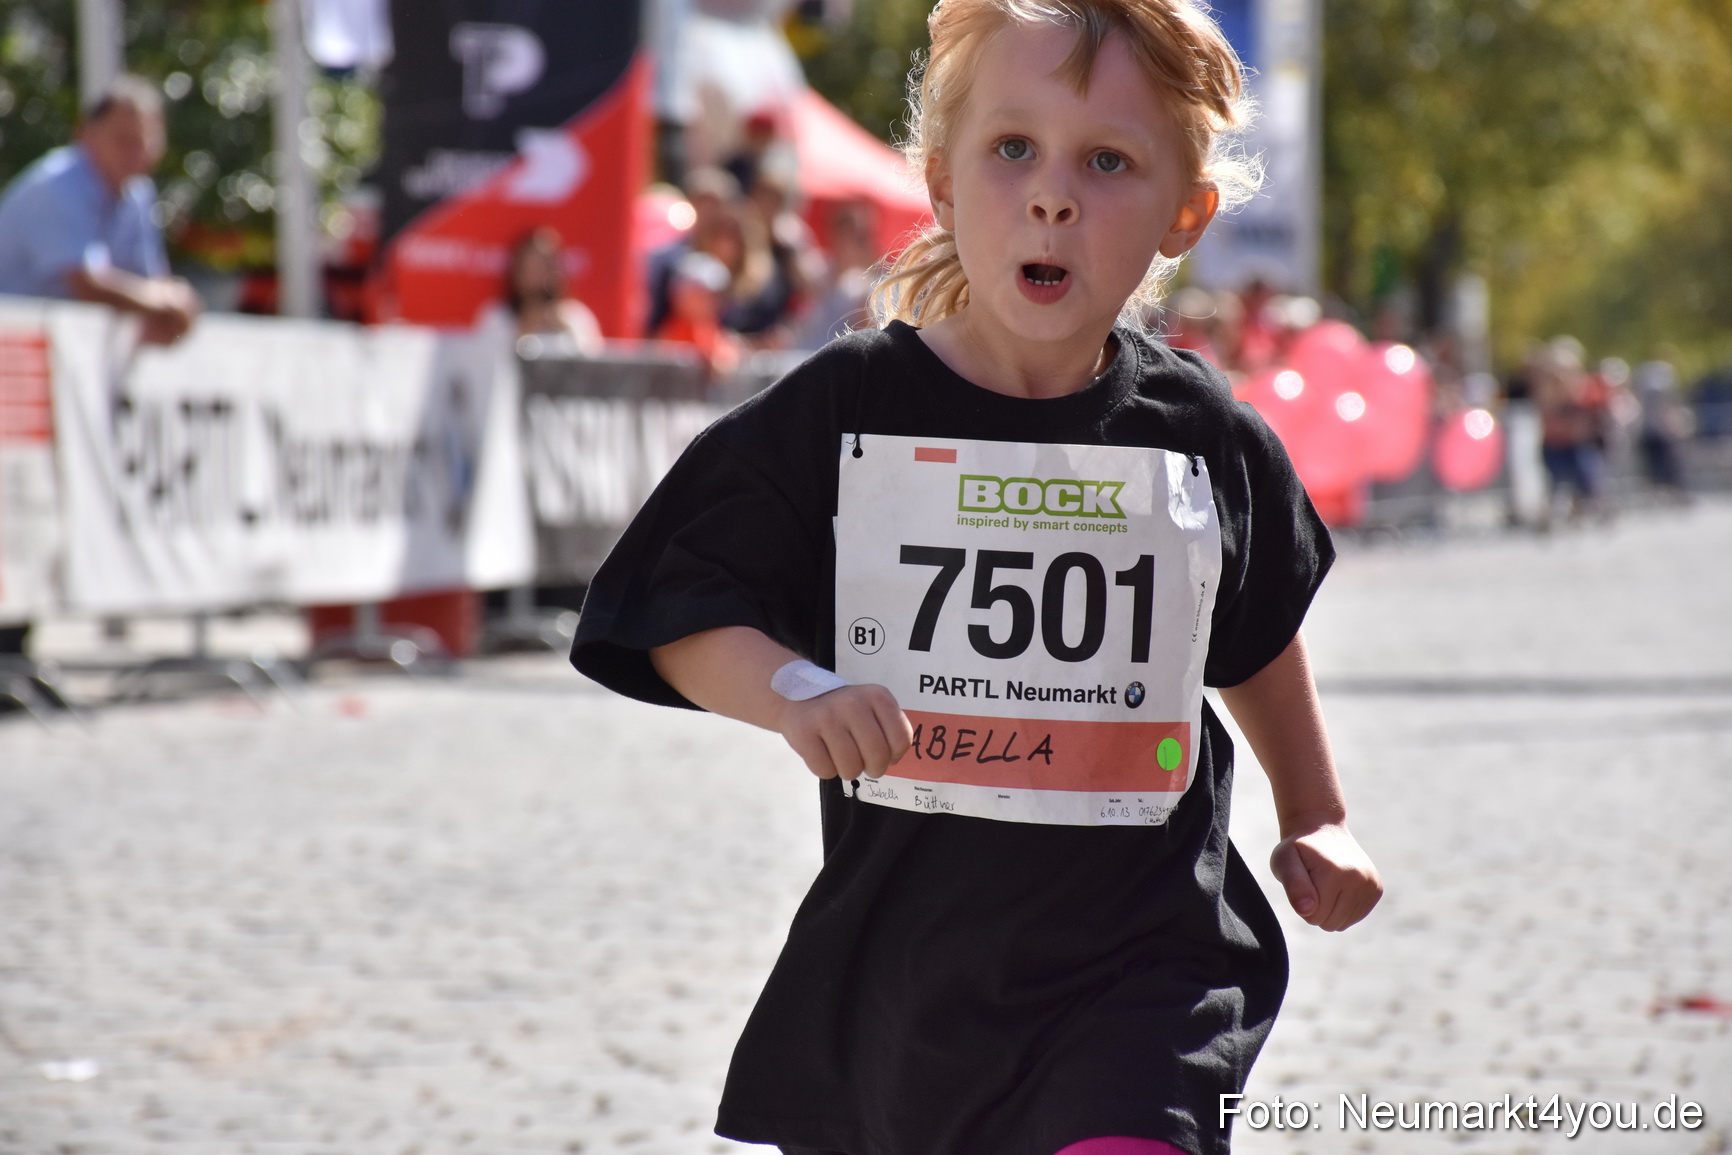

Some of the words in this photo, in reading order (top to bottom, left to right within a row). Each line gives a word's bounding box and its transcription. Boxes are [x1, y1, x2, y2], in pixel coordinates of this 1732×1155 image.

[958, 474, 1127, 519] BOCK
[957, 514, 1009, 528] inspired
[1013, 517, 1029, 531] by
[1032, 520, 1069, 530] smart
[1073, 522, 1128, 534] concepts
[900, 544, 1155, 663] 7501
[854, 627, 876, 646] B1
[919, 674, 999, 699] PARTL
[1006, 681, 1117, 704] Neumarkt
